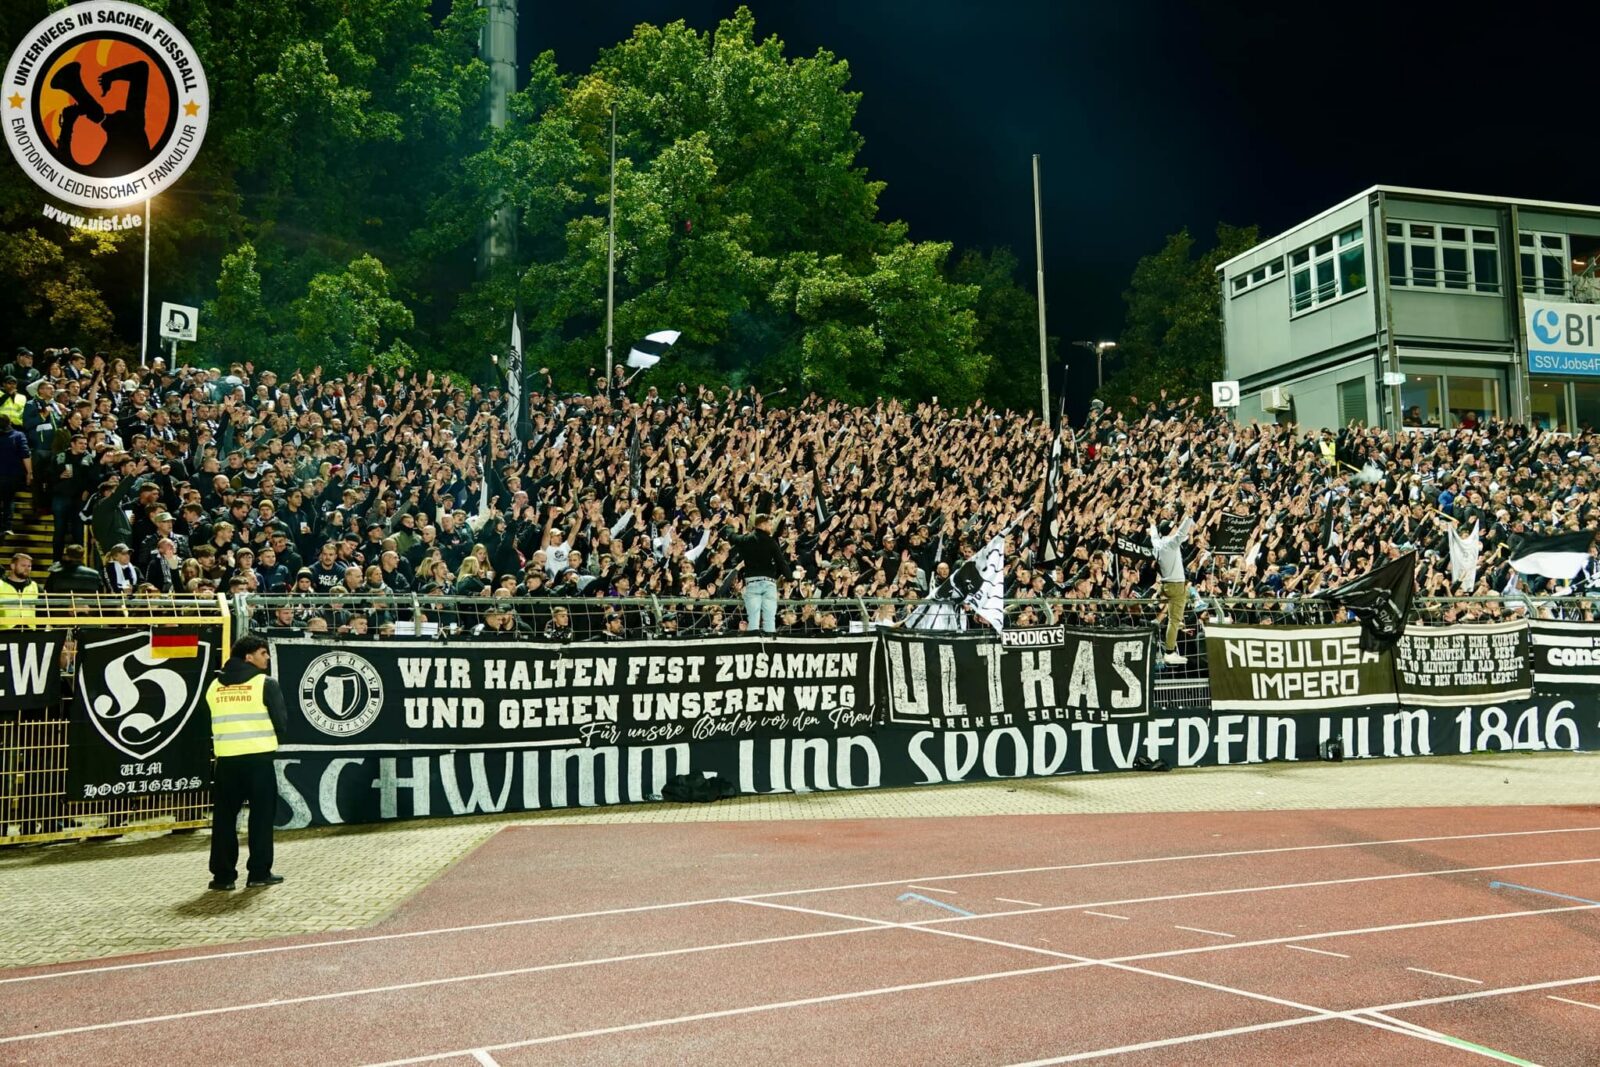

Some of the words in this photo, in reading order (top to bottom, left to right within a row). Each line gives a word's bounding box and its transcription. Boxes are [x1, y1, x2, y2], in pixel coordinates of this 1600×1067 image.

[168, 309, 190, 333] D
[1565, 312, 1600, 347] BI
[1218, 385, 1234, 402] D
[1002, 629, 1064, 645] PRODIGYS
[1469, 647, 1491, 660] LANG
[0, 642, 55, 696] W
[398, 657, 472, 689] WIR
[484, 656, 618, 690] HALTEN
[626, 655, 706, 686] FEST
[715, 652, 858, 683] ZUSAMMEN
[1251, 669, 1360, 700] IMPERO
[216, 695, 252, 704] STEWARD
[404, 697, 485, 729] UND
[499, 694, 619, 729] GEHEN
[632, 686, 786, 721] UNSEREN
[793, 684, 856, 712] WEG
[578, 721, 622, 748] Für
[627, 717, 685, 741] unsere
[691, 708, 758, 741] Brüder
[760, 713, 790, 730] vor
[792, 709, 821, 732] den
[931, 713, 1014, 729] BROKEN
[1027, 708, 1110, 722] SOCIETY
[1455, 700, 1581, 753] 1846
[120, 762, 162, 776] ULM
[83, 776, 203, 799] HOOLIGANS
